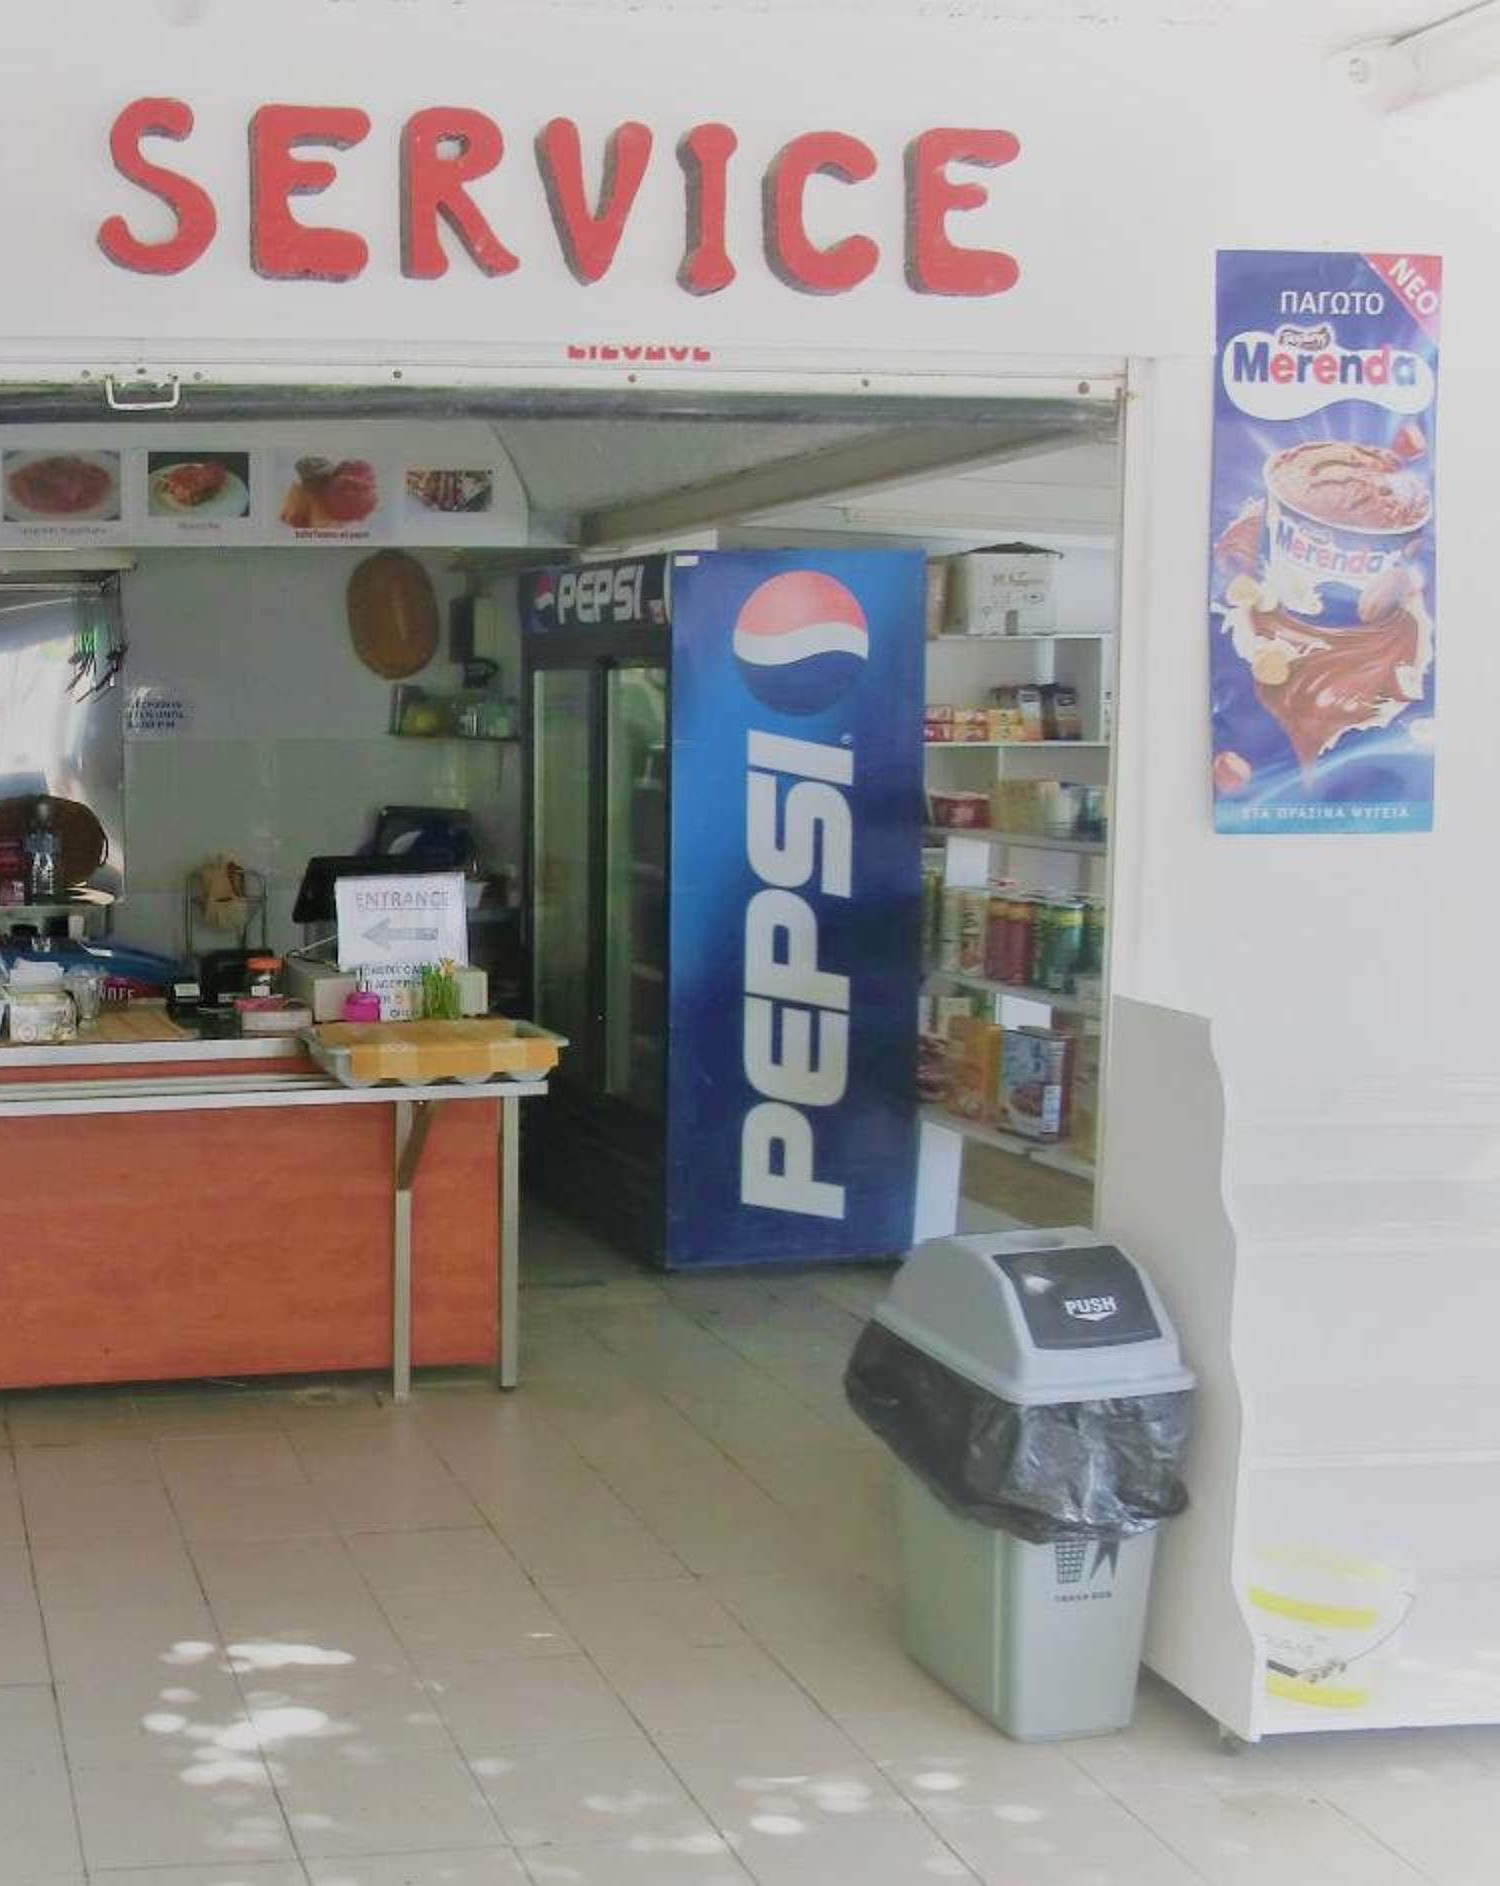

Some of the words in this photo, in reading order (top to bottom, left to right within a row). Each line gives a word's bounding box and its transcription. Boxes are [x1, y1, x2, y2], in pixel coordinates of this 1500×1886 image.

[98, 96, 1021, 296] SERVICE
[1280, 290, 1384, 315] ΠΑΓΩΤΟ
[1233, 341, 1417, 385] Merenda
[558, 564, 645, 625] PEPSI
[741, 729, 855, 1220] PEPSI
[1064, 1295, 1117, 1314] PUSH
